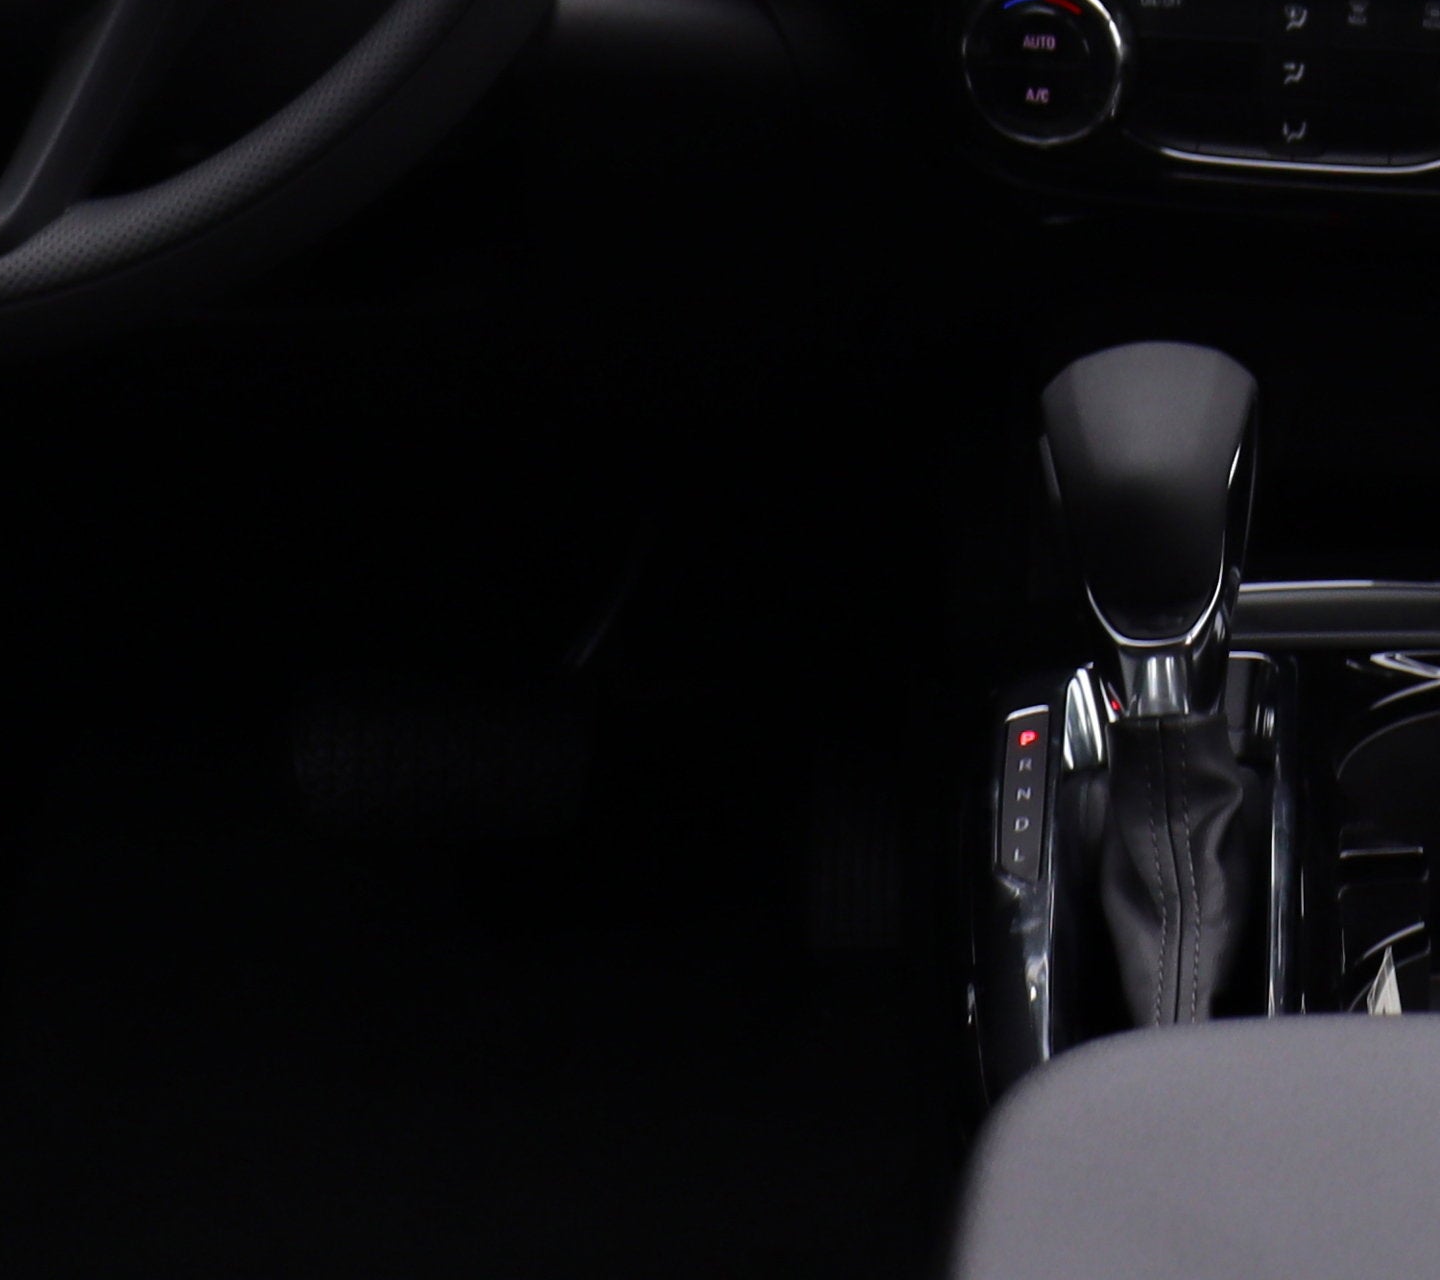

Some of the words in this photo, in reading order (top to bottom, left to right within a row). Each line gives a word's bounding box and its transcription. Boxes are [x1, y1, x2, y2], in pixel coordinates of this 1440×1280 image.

[1021, 34, 1057, 51] AUTO
[1025, 87, 1051, 105] A/C
[1019, 729, 1037, 747] P
[1018, 757, 1033, 772] R
[1016, 786, 1033, 800] N
[1014, 817, 1030, 832] D
[1013, 847, 1024, 863] L
